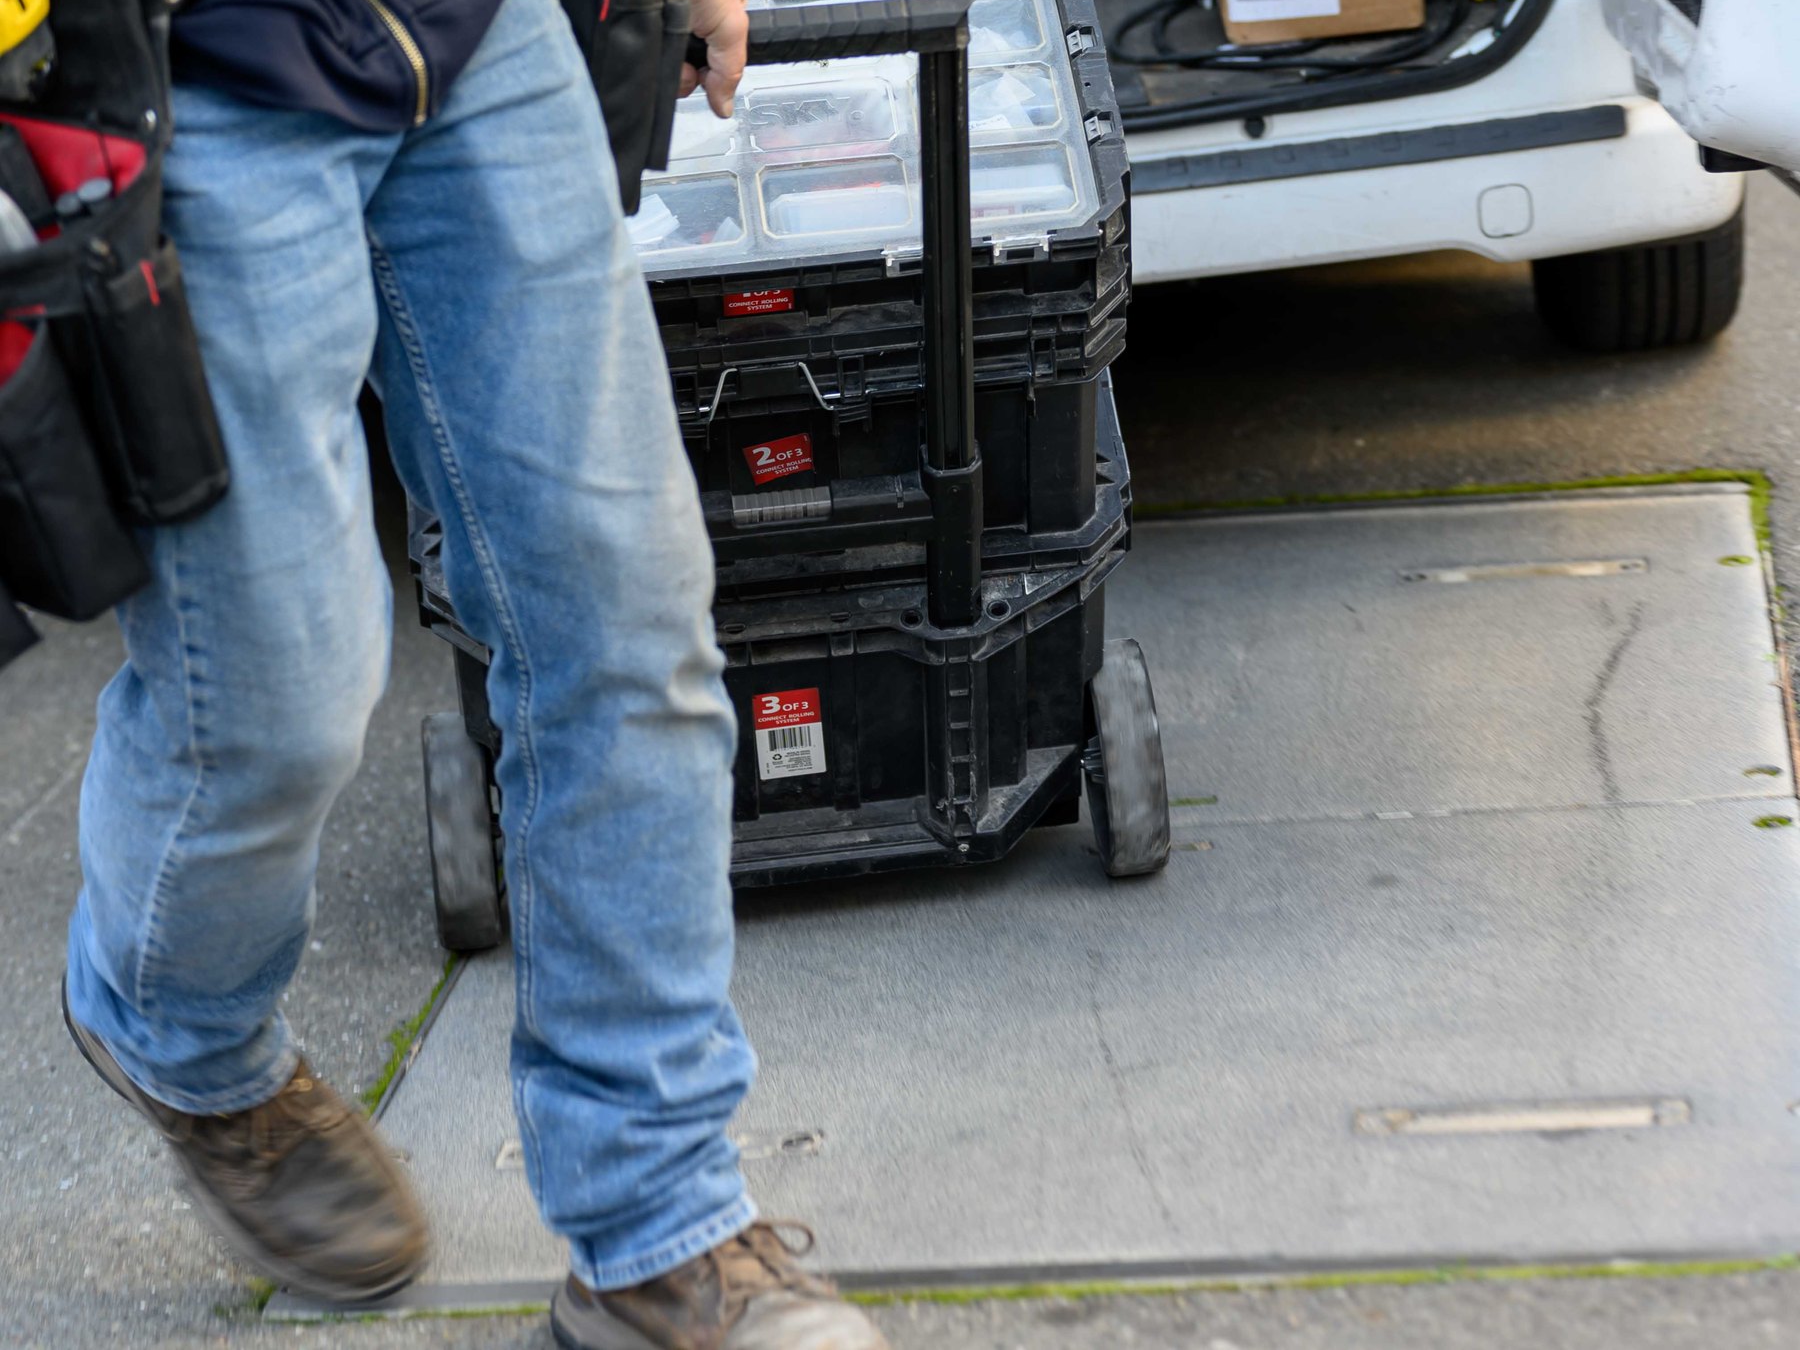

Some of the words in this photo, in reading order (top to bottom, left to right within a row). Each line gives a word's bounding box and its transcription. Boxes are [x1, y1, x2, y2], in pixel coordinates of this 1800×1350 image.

[728, 300, 759, 308] CONNECT
[752, 446, 776, 466] 2
[776, 450, 793, 461] OF
[794, 448, 803, 457] 3
[756, 463, 785, 475] CONNECT
[786, 457, 812, 467] ROLLING
[774, 465, 799, 475] SYSTEM
[761, 696, 781, 715] 3
[782, 702, 800, 712] OF
[801, 701, 809, 710] 3
[757, 714, 787, 723] CONNECT
[775, 717, 800, 725] SYSTEM
